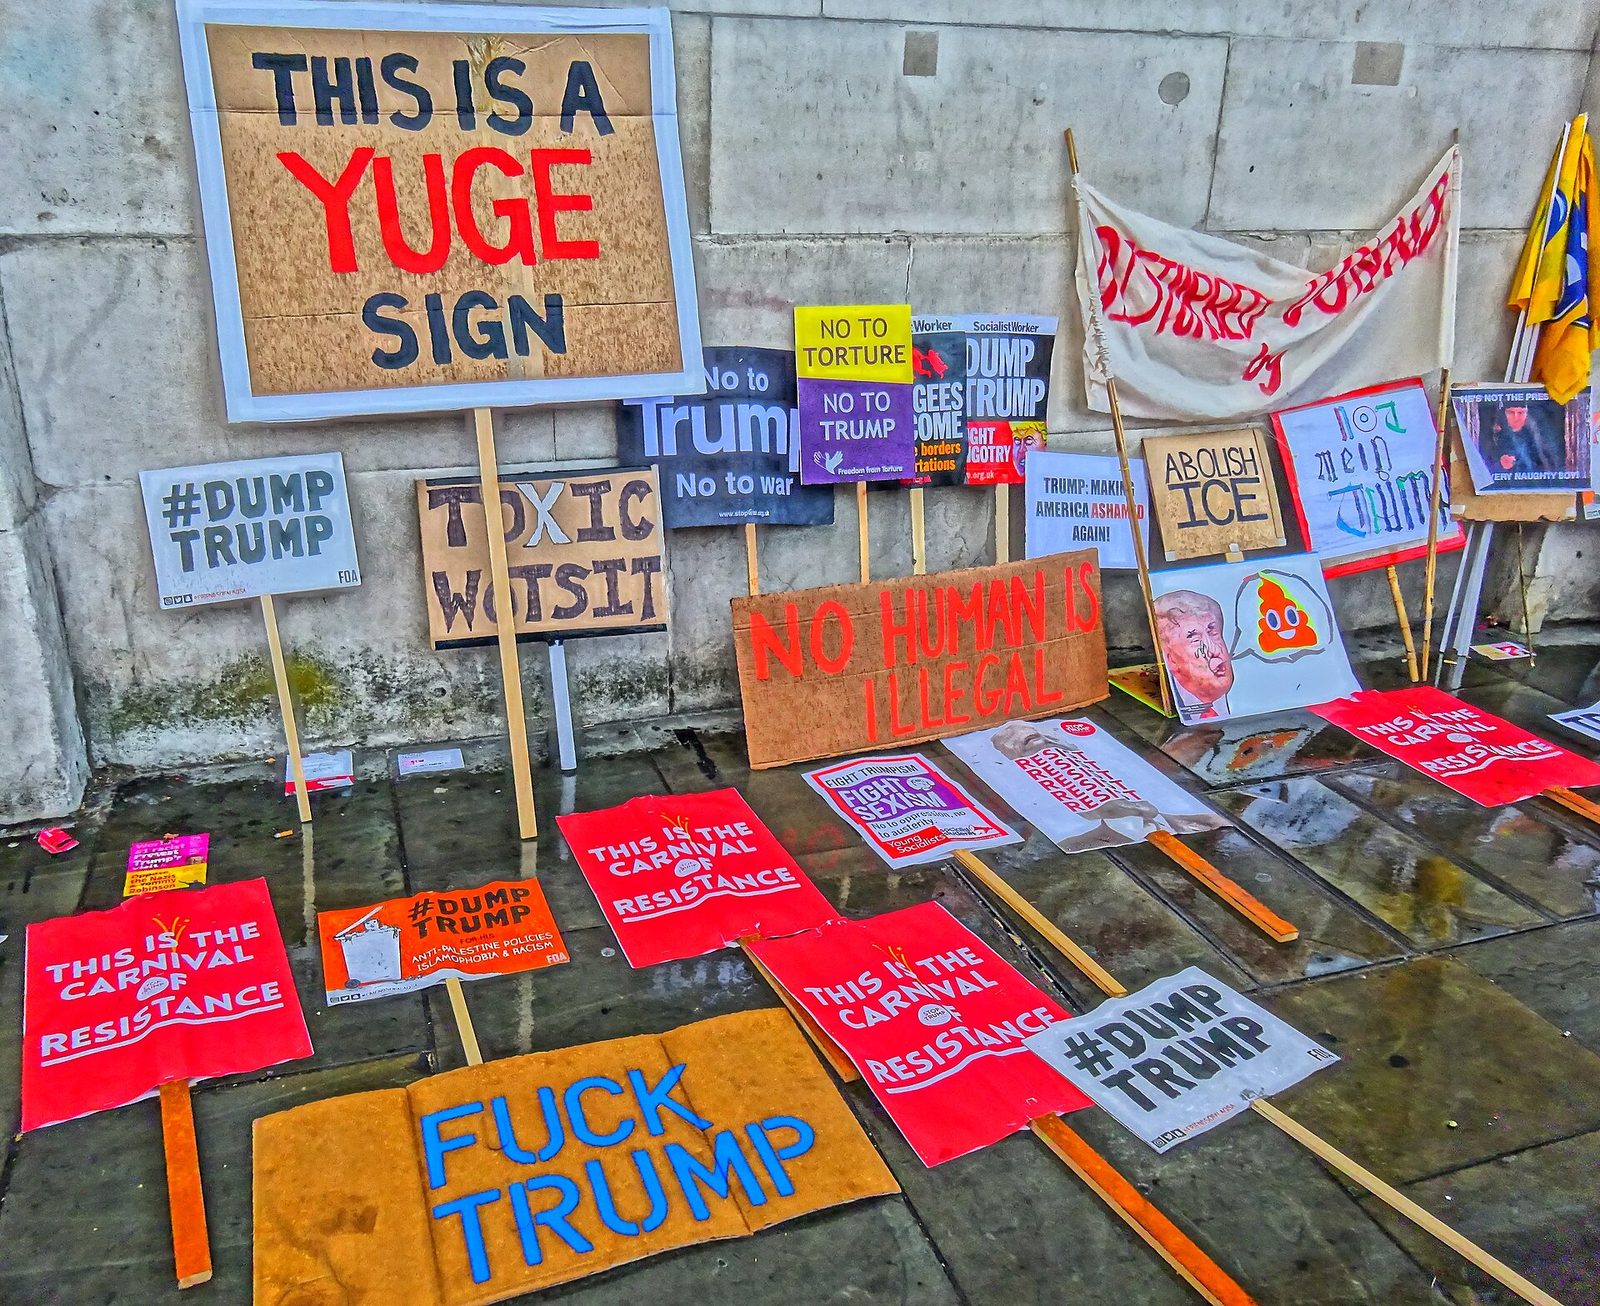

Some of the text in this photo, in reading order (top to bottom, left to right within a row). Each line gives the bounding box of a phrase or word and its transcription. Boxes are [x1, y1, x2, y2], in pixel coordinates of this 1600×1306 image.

[252, 52, 614, 136] THIS IS A
[277, 147, 600, 273] YUGE
[362, 292, 567, 370] SIGN
[821, 317, 887, 339] NO TO
[803, 345, 906, 367] TORTURE
[966, 338, 1035, 378] DUMP
[704, 366, 769, 392] No to
[823, 391, 891, 414] NO TO
[1485, 393, 1503, 402] NOT
[1505, 393, 1524, 401] THE
[819, 418, 896, 441] TRUMP
[921, 441, 961, 456] borders
[838, 465, 903, 476] Freedom from Torture
[1165, 447, 1258, 484] ABOLISH
[1515, 471, 1557, 480] NAUGHTY
[162, 470, 334, 529] #DUMP
[676, 472, 793, 497] No to war
[1043, 477, 1088, 494] TRUMP:
[427, 479, 654, 547] TOXIC
[1035, 501, 1144, 519] AMERICA ASHAMD
[1167, 477, 1268, 529] ICE
[170, 514, 333, 572] TRUMP
[1072, 525, 1110, 542] AGAIN!
[338, 569, 358, 584] FOA
[432, 556, 661, 633] WOTSIT
[750, 560, 1099, 681] NO HUMAN IS
[864, 648, 1064, 743] ILLEGAL
[1357, 716, 1414, 737] THIS
[1430, 708, 1480, 721] THE
[825, 764, 919, 788] FIGHT TRUMPISM
[838, 778, 909, 808] FIGHT
[853, 791, 948, 820] SEXISM
[872, 822, 887, 830] No
[888, 820, 898, 828] to
[878, 831, 890, 839] to
[887, 834, 922, 848] Young
[588, 822, 753, 862] THIS IS THE
[609, 839, 757, 877] CARNIVAL
[896, 834, 946, 854] Socialists
[408, 888, 530, 920] #DUMP
[613, 867, 796, 915] RESISTANCE
[412, 905, 531, 939] TRUMP
[46, 921, 261, 983] THIS IS THE
[412, 932, 553, 963] ANTI-PALESTINE POLICIES
[417, 951, 499, 972] ISLAMOPHOBIA
[513, 942, 553, 956] RACISM
[546, 952, 568, 964] FOA
[61, 946, 254, 1001] CARNIVAL
[804, 970, 882, 1007] THIS
[917, 947, 984, 975] THE
[839, 970, 999, 1030] CARNIVAL
[41, 981, 282, 1057] RESISTANCE
[1063, 984, 1228, 1077] #DUMP
[865, 1006, 1055, 1084] RESISTANCE
[1100, 1016, 1272, 1112] TRUMP
[421, 1064, 713, 1190] FUCK
[432, 1115, 816, 1284] TRUMP
